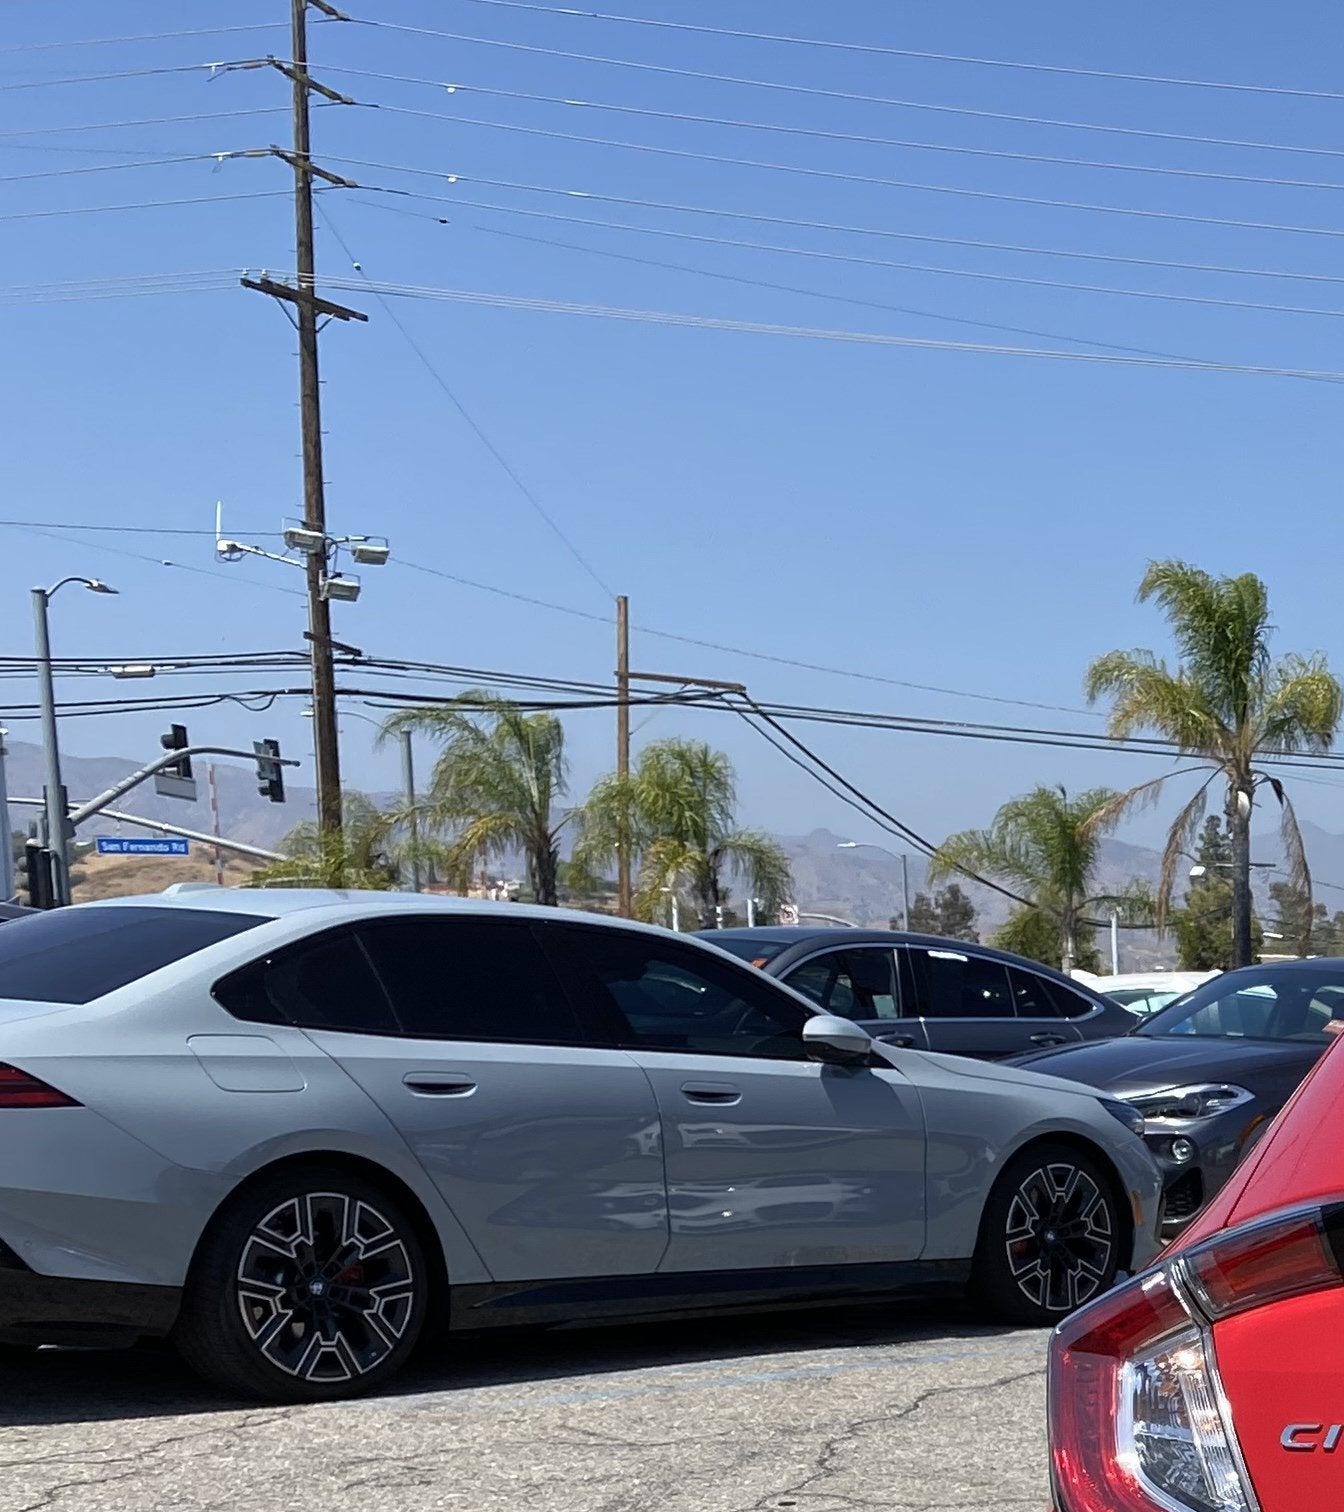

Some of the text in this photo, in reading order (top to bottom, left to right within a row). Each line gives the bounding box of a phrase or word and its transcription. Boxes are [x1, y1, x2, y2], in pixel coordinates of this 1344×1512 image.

[101, 841, 186, 853] San Fernando Rd
